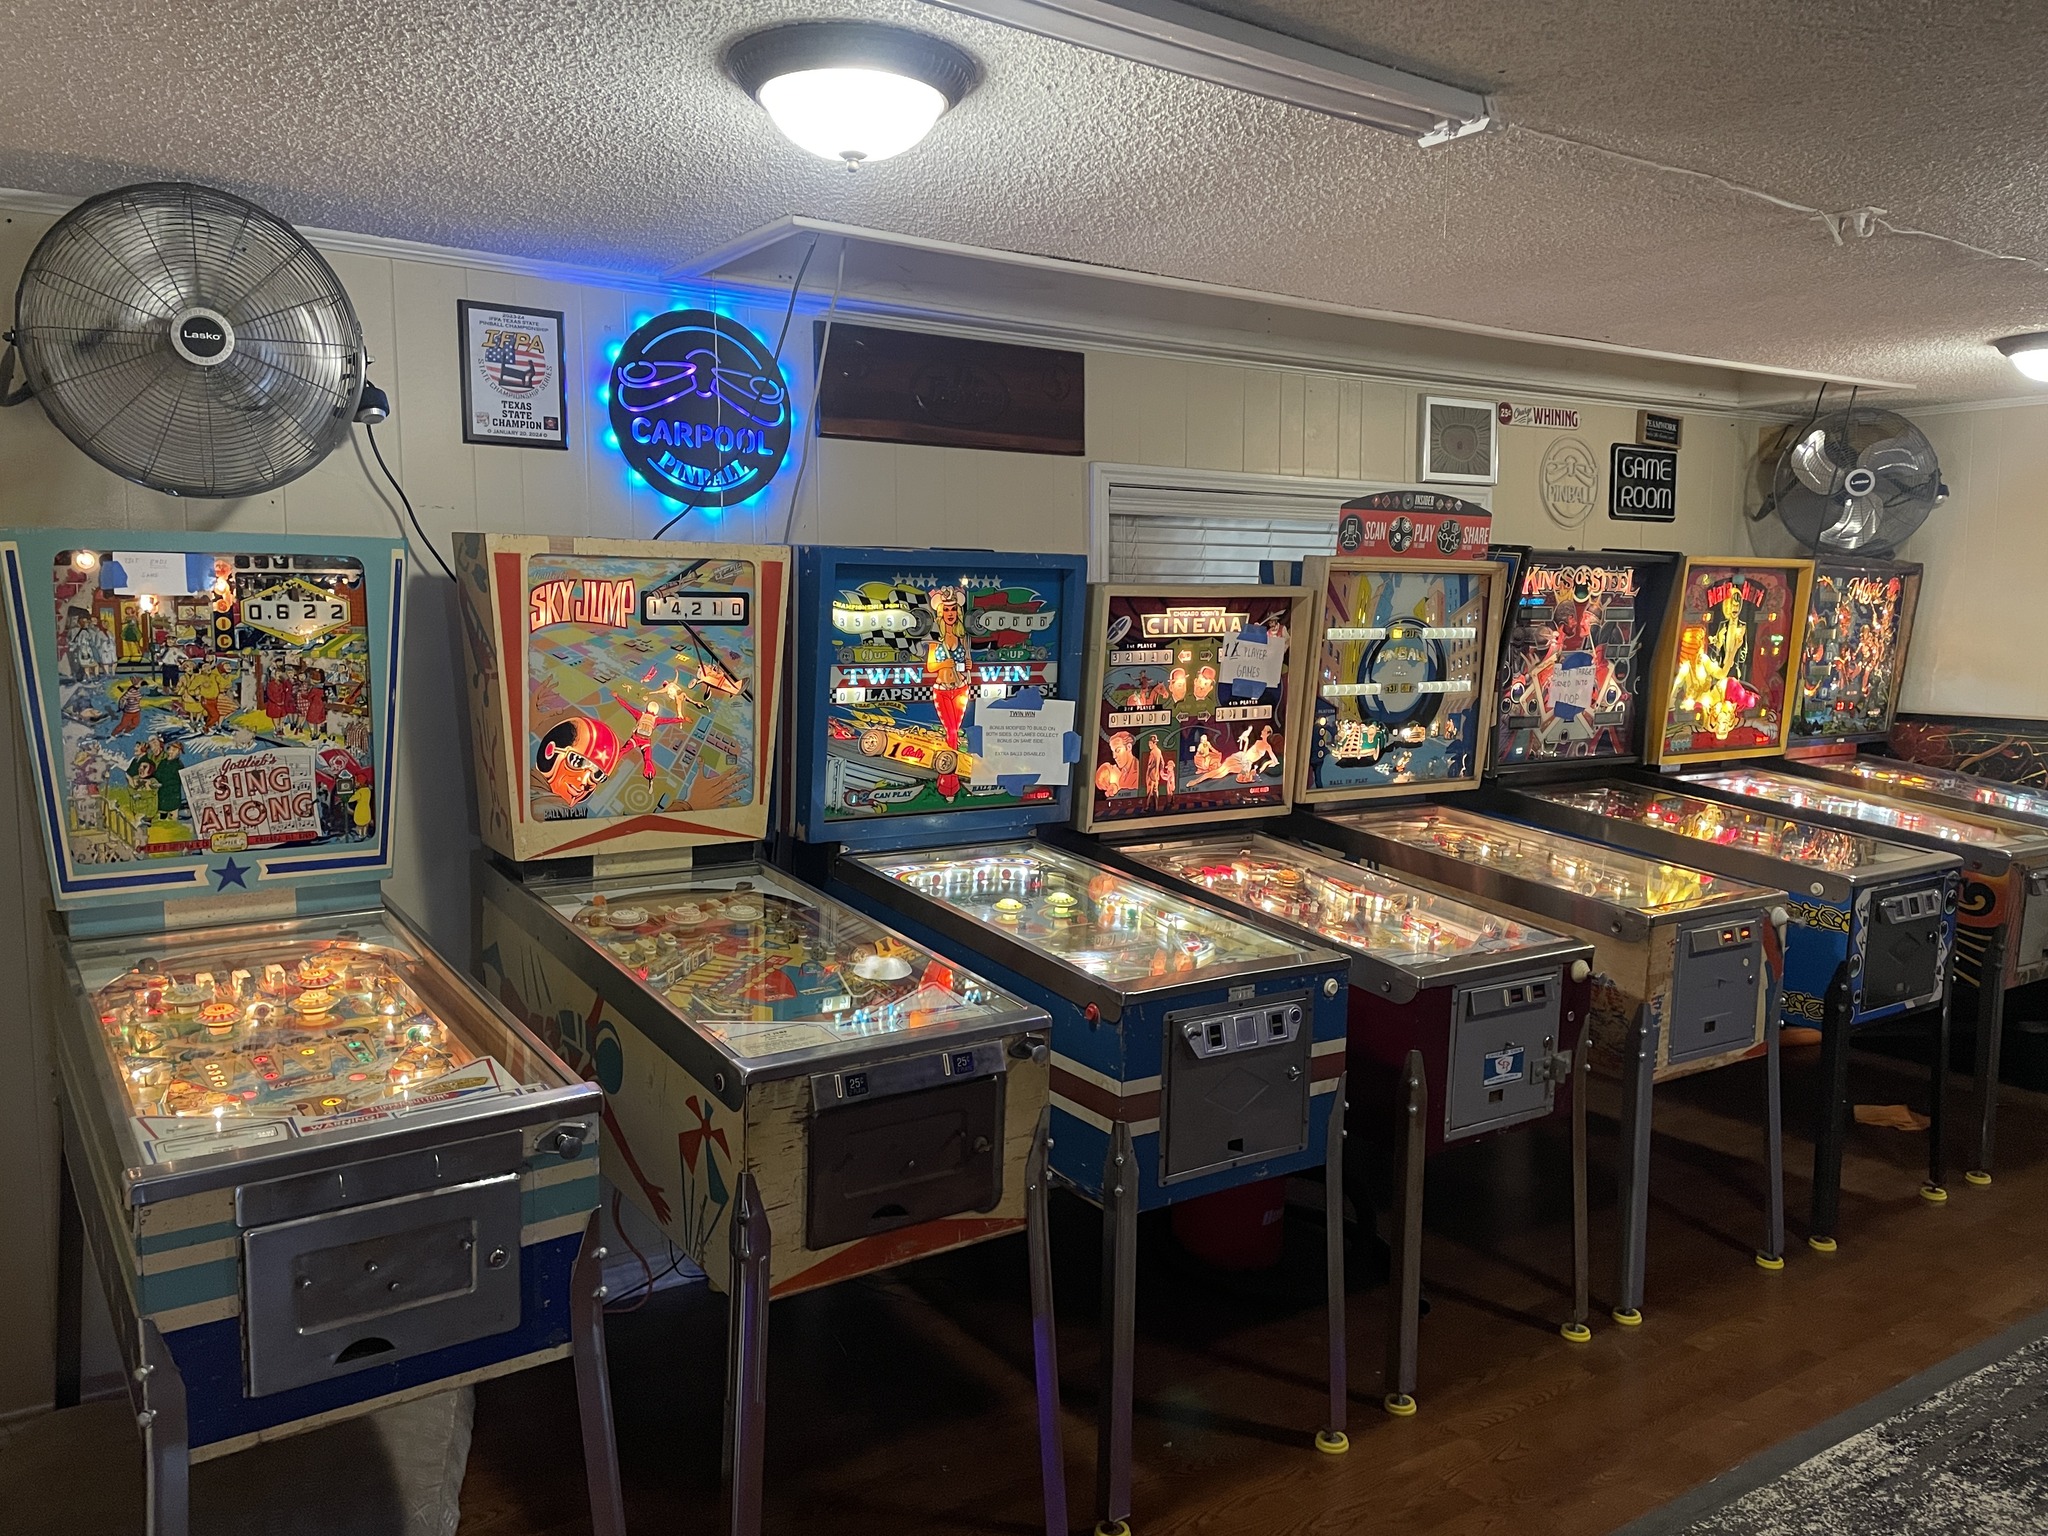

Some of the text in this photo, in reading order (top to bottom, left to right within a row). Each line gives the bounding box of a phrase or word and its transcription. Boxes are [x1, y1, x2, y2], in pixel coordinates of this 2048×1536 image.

[479, 320, 549, 332] PINBALL CHAMPIONSHIP
[503, 317, 521, 325] TEXAS
[184, 330, 221, 340] Lasko
[481, 329, 544, 353] IFPA
[477, 358, 553, 400] STATE CHAMPIONSHIP SERIES
[501, 400, 532, 411] TEXAS
[502, 410, 532, 420] STATE
[1500, 408, 1511, 417] 25¢
[1513, 407, 1532, 420] Charge
[1533, 407, 1578, 427] WHINING
[492, 418, 542, 430] CHAMPION
[631, 416, 774, 456] CARPOOL
[1622, 456, 1672, 480] GAME
[1415, 495, 1435, 506] INSIDER
[1549, 485, 1595, 506] PINBALL
[1620, 486, 1672, 510] ROOM
[1364, 521, 1489, 545] SCAN PLAY SHARE
[1521, 566, 1641, 598] KINGS OF STEEL
[1847, 575, 1888, 605] Magic
[530, 578, 635, 633] SKY JUMP
[1146, 617, 1242, 634] CINEMA
[873, 651, 888, 659] UP
[1009, 650, 1024, 659] UP
[1244, 647, 1268, 660] PLAYER
[1376, 647, 1428, 664] PINBALL
[843, 665, 1032, 686] TWIN WIN
[1236, 665, 1261, 678] GAMES
[866, 688, 914, 702] LAPS
[1558, 692, 1580, 704] LOOP
[1009, 710, 1036, 719] TWIN WIN
[888, 742, 926, 761] 1 Bally
[220, 752, 278, 774] Gottlieb's
[213, 766, 292, 801] SING
[873, 791, 890, 799] CAN
[891, 790, 913, 799] PLAY
[200, 792, 315, 834] ALONG
[544, 808, 560, 819] BALL
[570, 807, 587, 817] PLAY
[684, 957, 691, 973] 4
[956, 1056, 970, 1068] 25¢
[849, 1077, 864, 1089] 25¢
[310, 1113, 380, 1131] WARNING!
